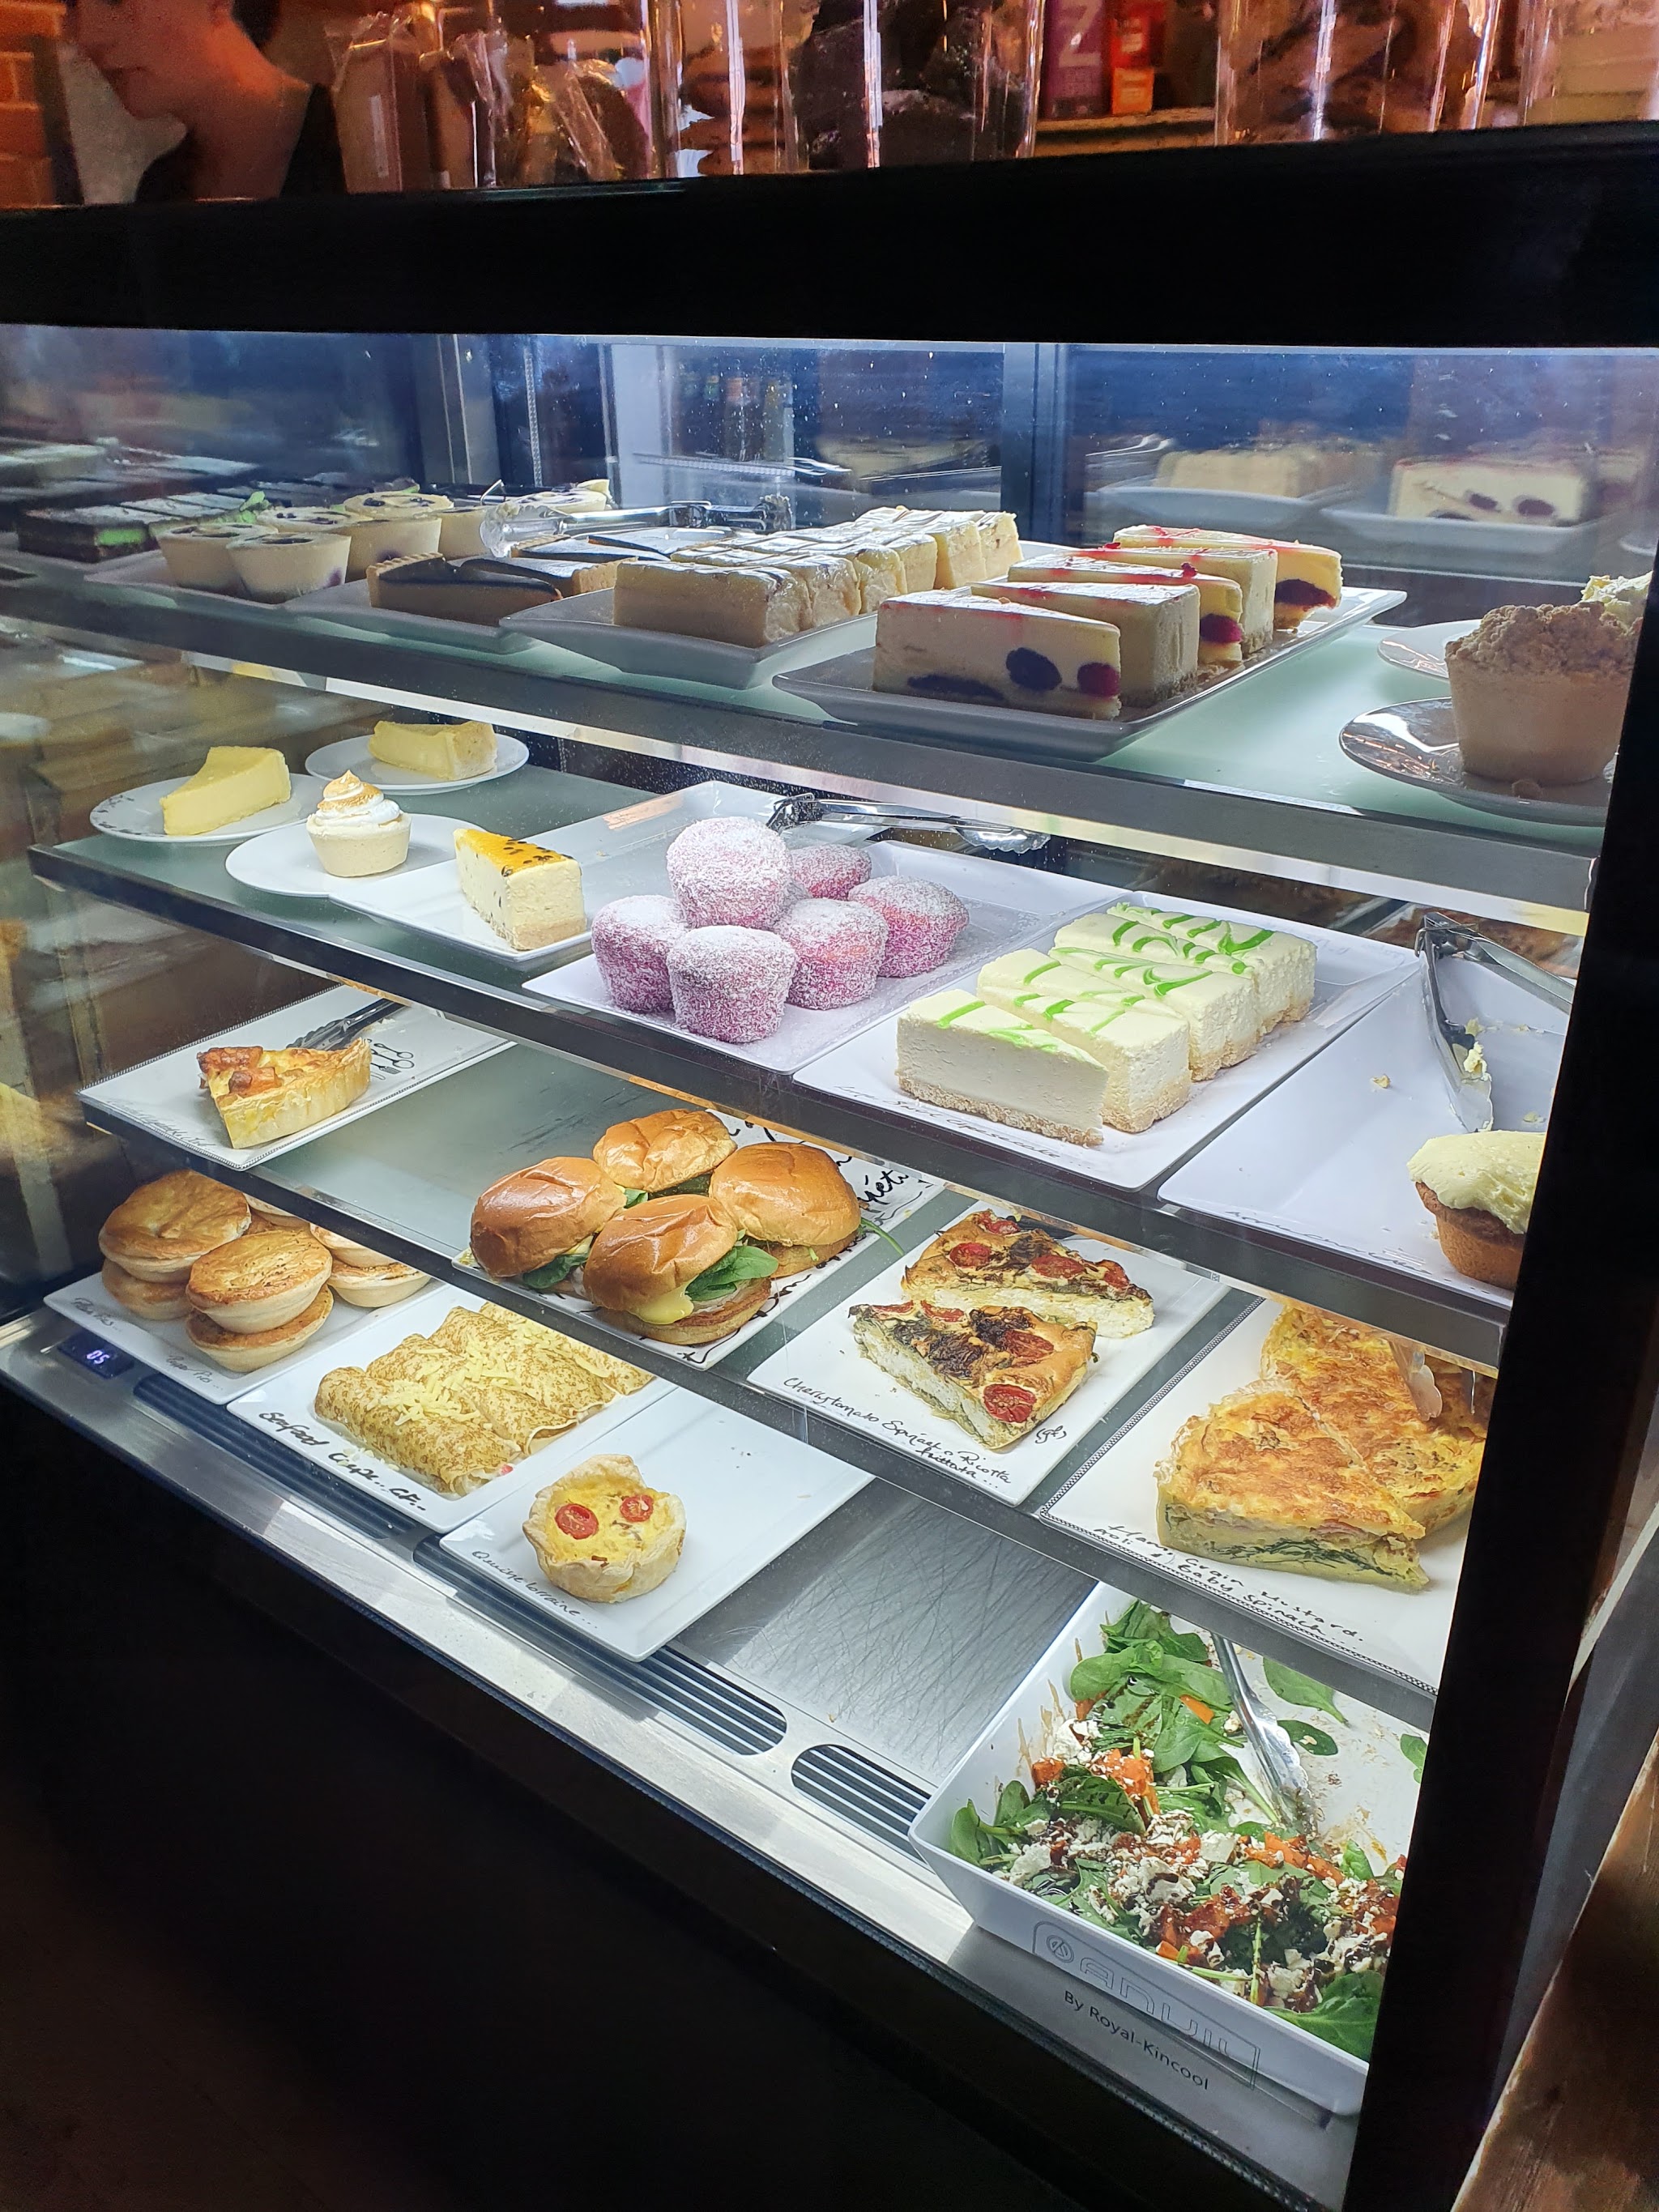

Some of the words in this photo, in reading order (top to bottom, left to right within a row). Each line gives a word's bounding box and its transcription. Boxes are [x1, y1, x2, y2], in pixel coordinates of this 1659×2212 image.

[86, 1349, 111, 1365] 05
[1064, 1989, 1085, 2012] By
[1089, 2005, 1209, 2091] Royal-Kincool
